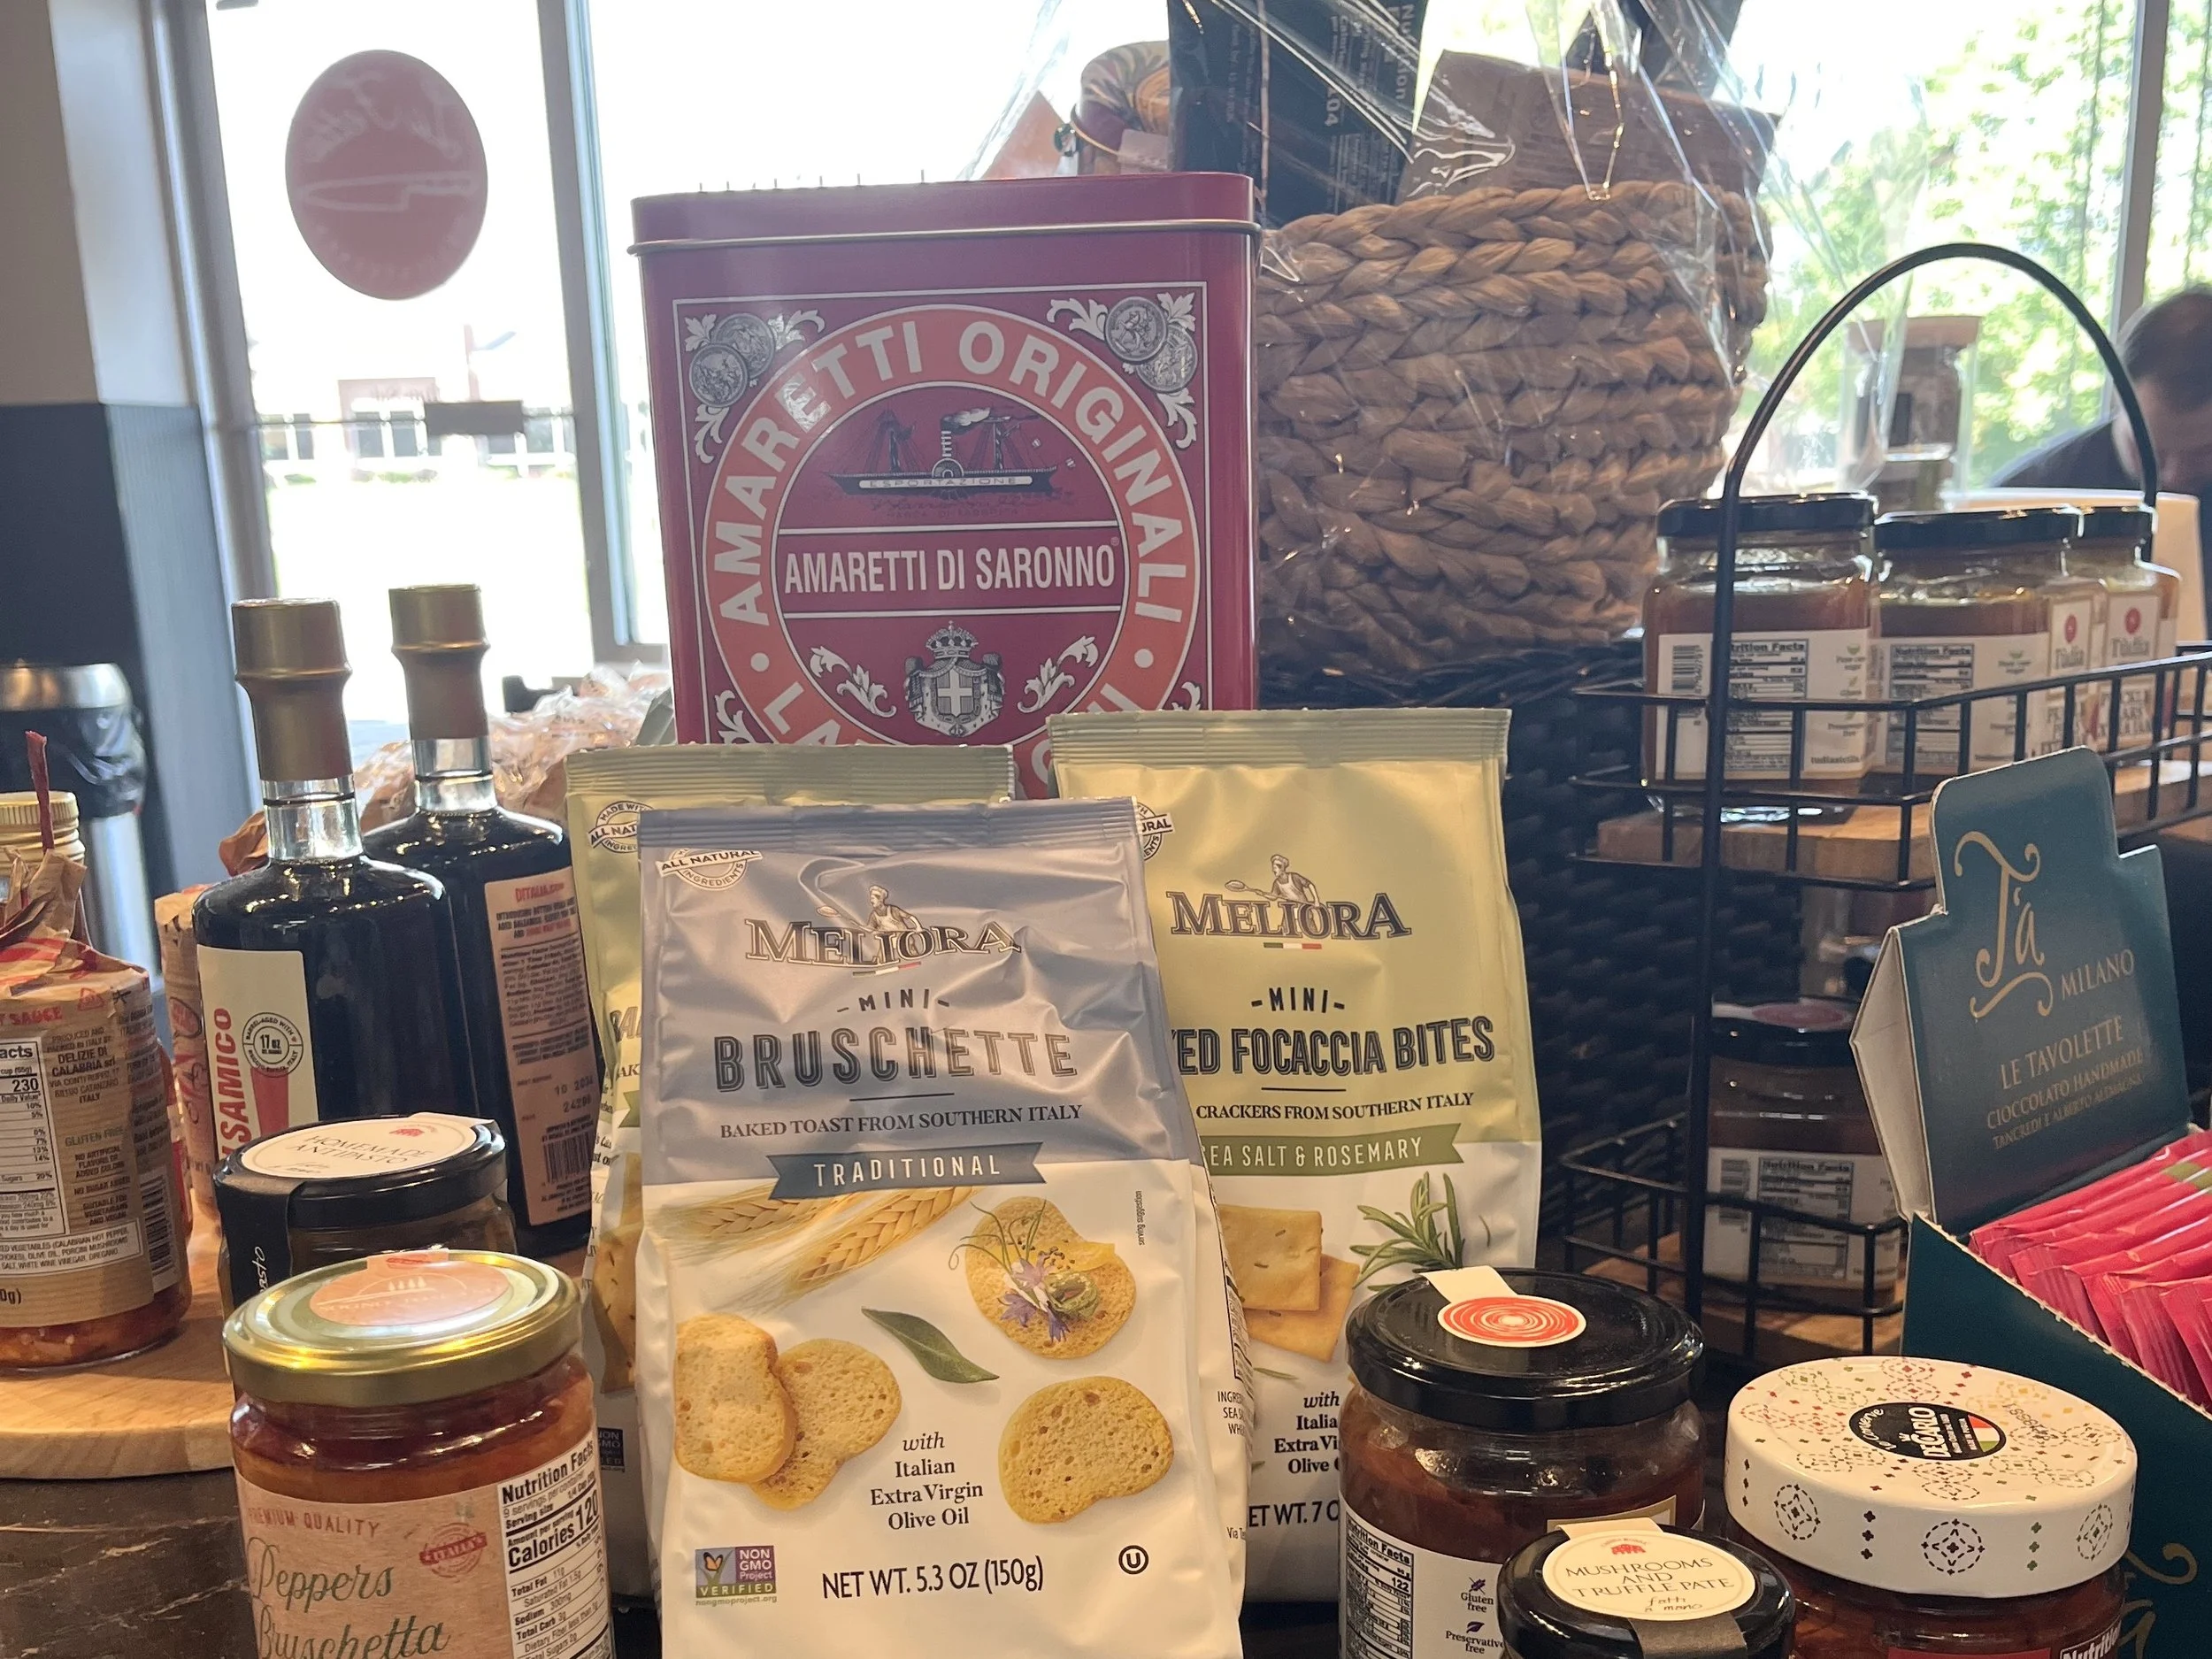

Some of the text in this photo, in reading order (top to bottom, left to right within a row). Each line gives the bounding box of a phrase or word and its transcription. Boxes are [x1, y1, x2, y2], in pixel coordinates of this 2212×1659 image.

[715, 320, 1187, 626] AMARETTI ORIGINALI
[870, 476, 1017, 488] ESPORTAZIONE
[785, 544, 1115, 595] AMARETTI DI SARONNO
[600, 804, 624, 821] MADE
[1142, 819, 1171, 832] URAL
[590, 828, 610, 845] ALL
[662, 850, 760, 871] ALL NATURAL
[683, 863, 743, 887] INGREDIENTS
[1166, 892, 1413, 941] MELIORA
[744, 918, 1023, 968] MELIORA
[2062, 949, 2134, 1002] MILANO
[10, 1006, 62, 1025] SAUCE
[279, 1020, 294, 1036] WITH
[260, 1034, 270, 1048] 17
[1231, 1028, 1387, 1077] FOCACCIA
[1393, 1016, 1495, 1071] BITES
[58, 1046, 107, 1064] DELIZIE DI
[713, 1026, 1078, 1094] BRUSCHETTE
[2001, 1015, 2124, 1090] LE TAVOLETTE
[51, 1060, 103, 1078] CALABRIA
[12, 1078, 38, 1093] 230
[214, 1008, 252, 1159] SAMICO
[1, 1094, 19, 1103] Daily
[80, 1093, 100, 1103] ITALY
[1196, 1092, 1475, 1120] CRACKERS FROM SOUTHERN ITALY
[1986, 1079, 2070, 1130] CIOCCOLATO
[719, 1103, 1083, 1139] BAKED TOAST FROM SOUTHERN ITALY
[304, 1134, 434, 1158] HOMEMADE
[1202, 1136, 1423, 1167] EA SALT & ROSEMARY
[813, 1155, 1002, 1188] TRADITIONAL
[74, 1187, 84, 1195] NO
[12, 1243, 51, 1252] VEGETABLES
[1303, 1391, 1340, 1409] with
[1296, 1414, 1338, 1431] Italia
[902, 1431, 946, 1453] with
[1274, 1438, 1318, 1453] Extra
[502, 1440, 593, 1504] Nutrition Facts
[895, 1456, 956, 1479] Italian
[1288, 1458, 1329, 1473] Olive
[511, 1495, 546, 1516] servings
[548, 1487, 558, 1502] per
[869, 1479, 985, 1506] Extra Virgin
[506, 1511, 537, 1529] Serving
[887, 1506, 971, 1531] Olive Oil
[1248, 1501, 1323, 1527] ET WT. 7
[303, 1512, 380, 1538] QUALITY
[508, 1522, 575, 1568] Calories
[576, 1489, 599, 1531] 120
[508, 1529, 538, 1548] Amount
[540, 1524, 550, 1537] per
[740, 1549, 770, 1559] NON
[1381, 1542, 1410, 1564] Facts
[247, 1536, 395, 1613] Peppers
[740, 1560, 772, 1571] GMO
[1565, 1557, 1714, 1578] MUSHROOMS
[511, 1576, 548, 1597] Total Fat
[740, 1571, 773, 1582] Project
[821, 1555, 1044, 1601] NET WT. 5.3 OZ (150g)
[1392, 1577, 1409, 1592] 122
[1622, 1572, 1673, 1584] AND
[524, 1586, 557, 1608] Saturated
[700, 1583, 773, 1596] VERIFIED
[1572, 1578, 1735, 1597] TRUFFLE PATE
[695, 1595, 778, 1607] nongmoproject.org
[1461, 1593, 1494, 1605] Gluten
[1467, 1601, 1487, 1613] free
[515, 1609, 544, 1626] Sodium
[517, 1625, 537, 1640] Total
[540, 1617, 556, 1631] Carb
[525, 1634, 550, 1653] Dietary
[546, 1639, 568, 1657] Sugars
[1465, 1642, 1485, 1654] free
